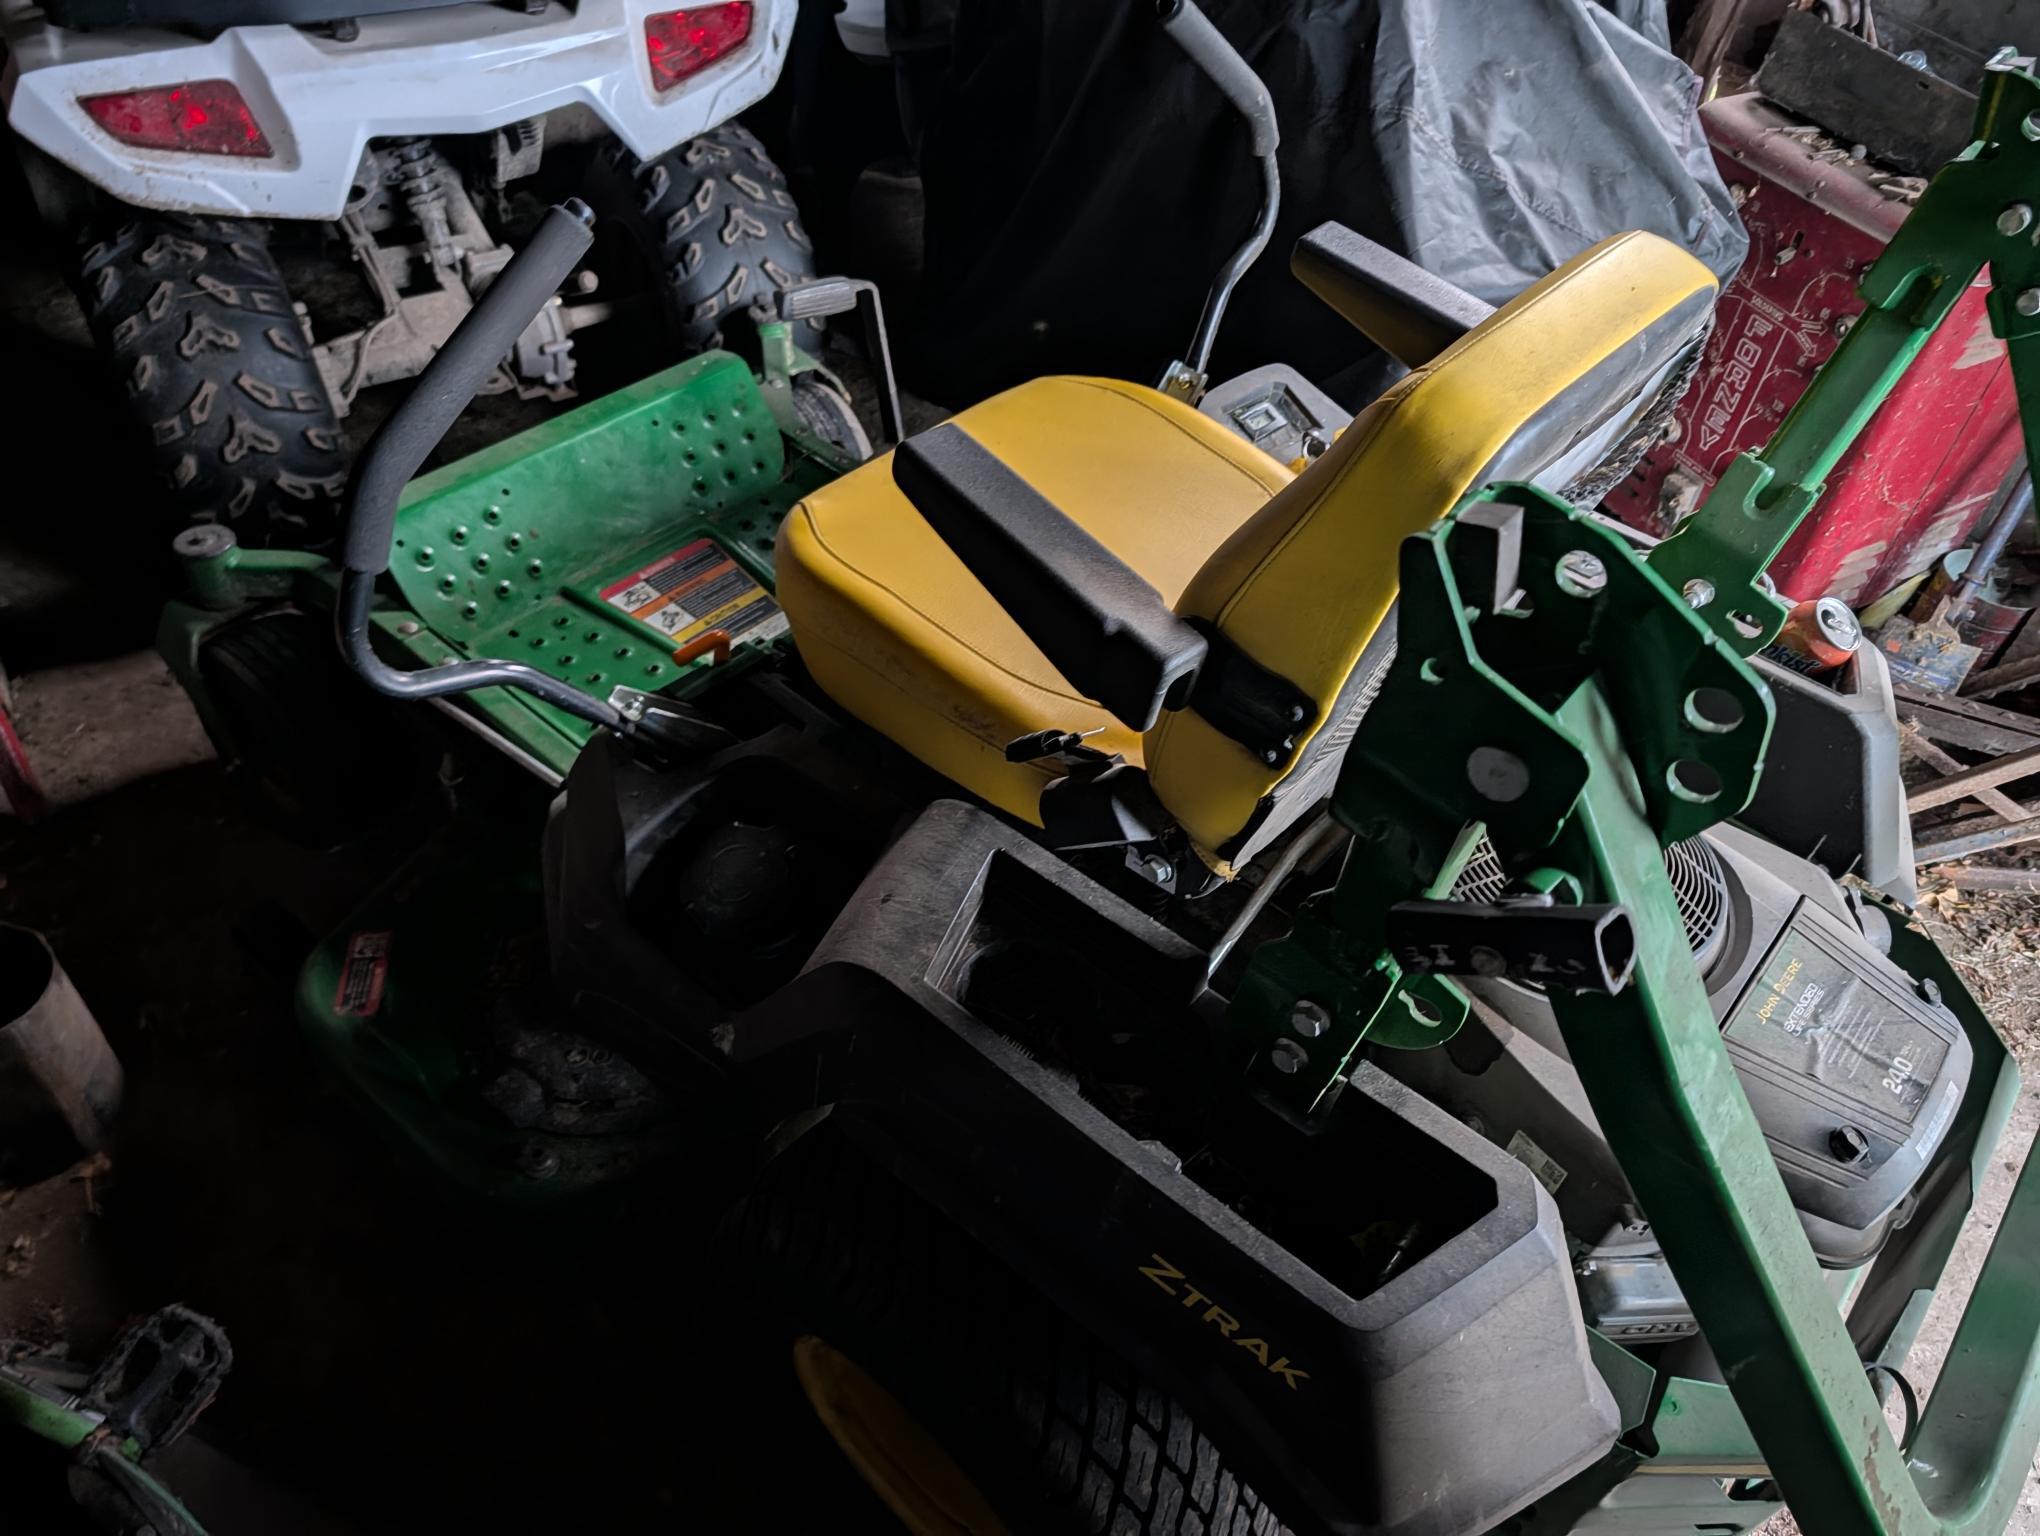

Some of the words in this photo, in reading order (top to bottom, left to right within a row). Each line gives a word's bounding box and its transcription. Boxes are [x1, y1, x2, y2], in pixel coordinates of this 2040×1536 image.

[1699, 313, 1773, 451] FORNEY
[1755, 995, 1779, 1024] JOHN
[1773, 958, 1802, 992] DEERE
[1783, 981, 1818, 1032] EXTENDED
[1137, 1252, 1310, 1390] ZTRAK
